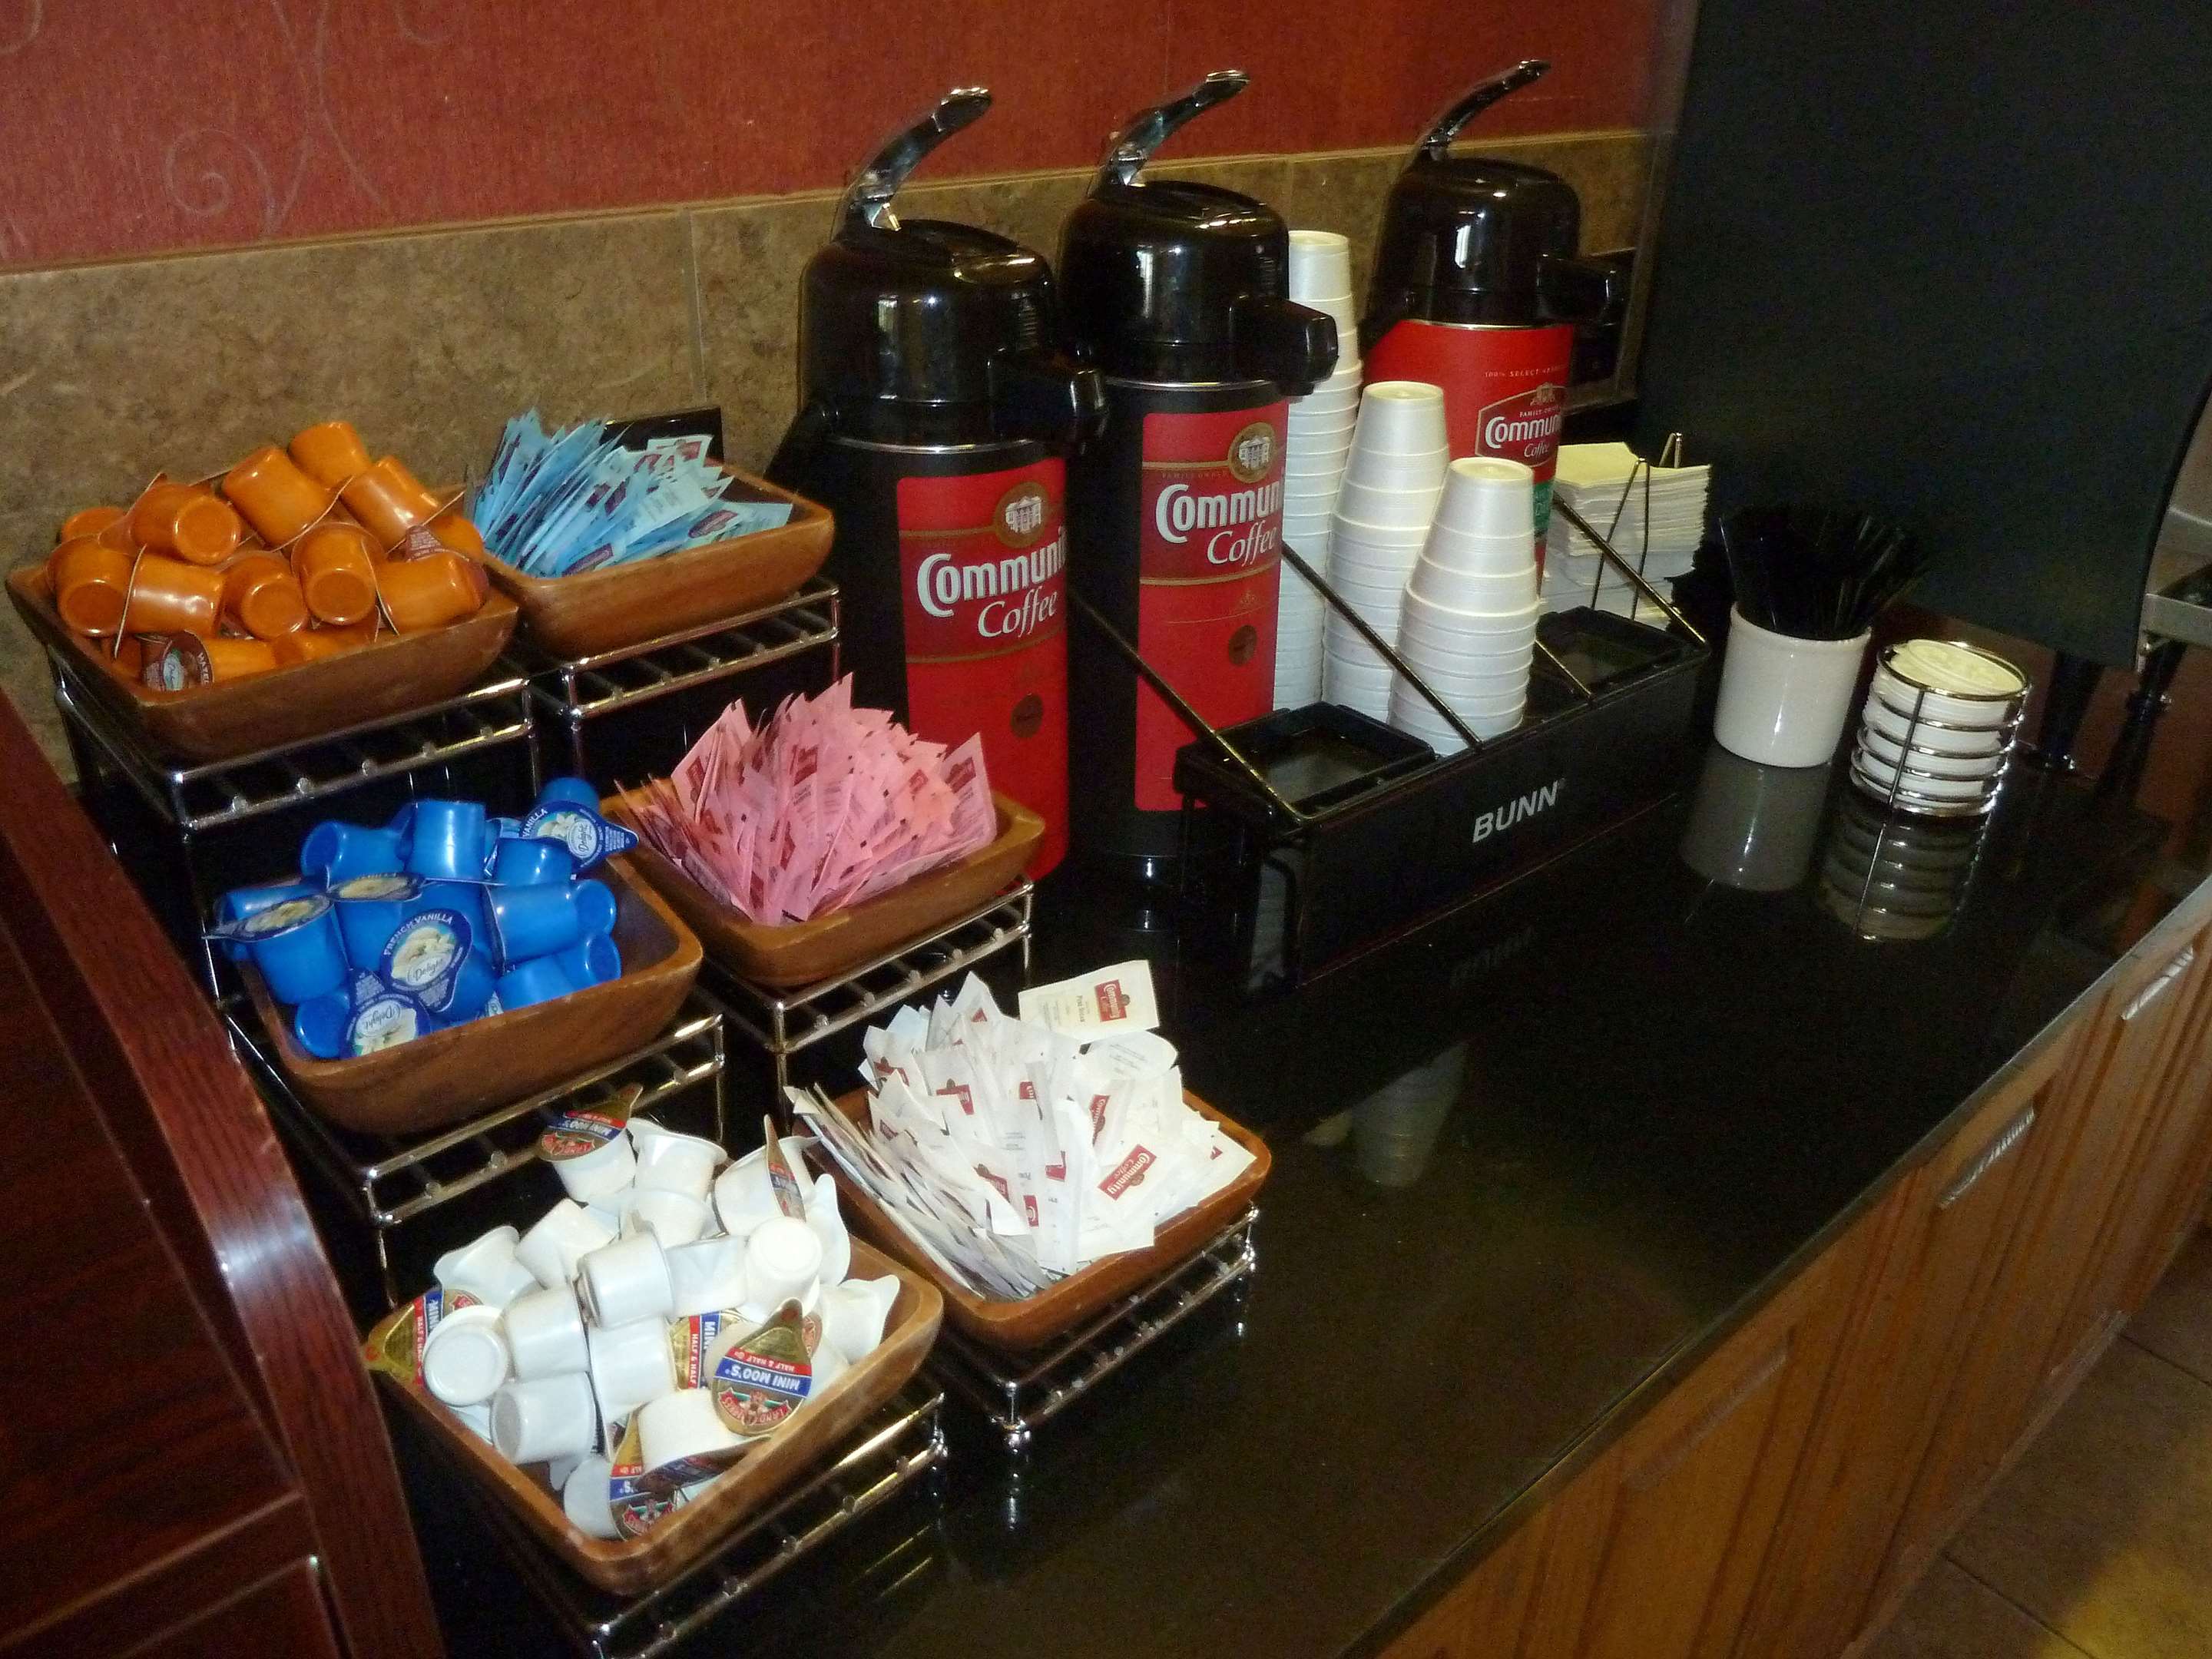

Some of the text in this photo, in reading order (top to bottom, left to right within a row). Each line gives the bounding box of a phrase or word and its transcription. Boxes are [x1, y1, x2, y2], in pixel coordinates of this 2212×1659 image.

[1485, 415, 1561, 449] Commun
[1207, 519, 1277, 568] Coffee
[978, 586, 1058, 637] Coffee
[522, 808, 548, 838] VANILLA
[1472, 780, 1558, 843] BUNN
[383, 912, 453, 955] FRENCH VANILLA
[1107, 1153, 1151, 1194] Community
[730, 1365, 801, 1391] MINI MOO'S
